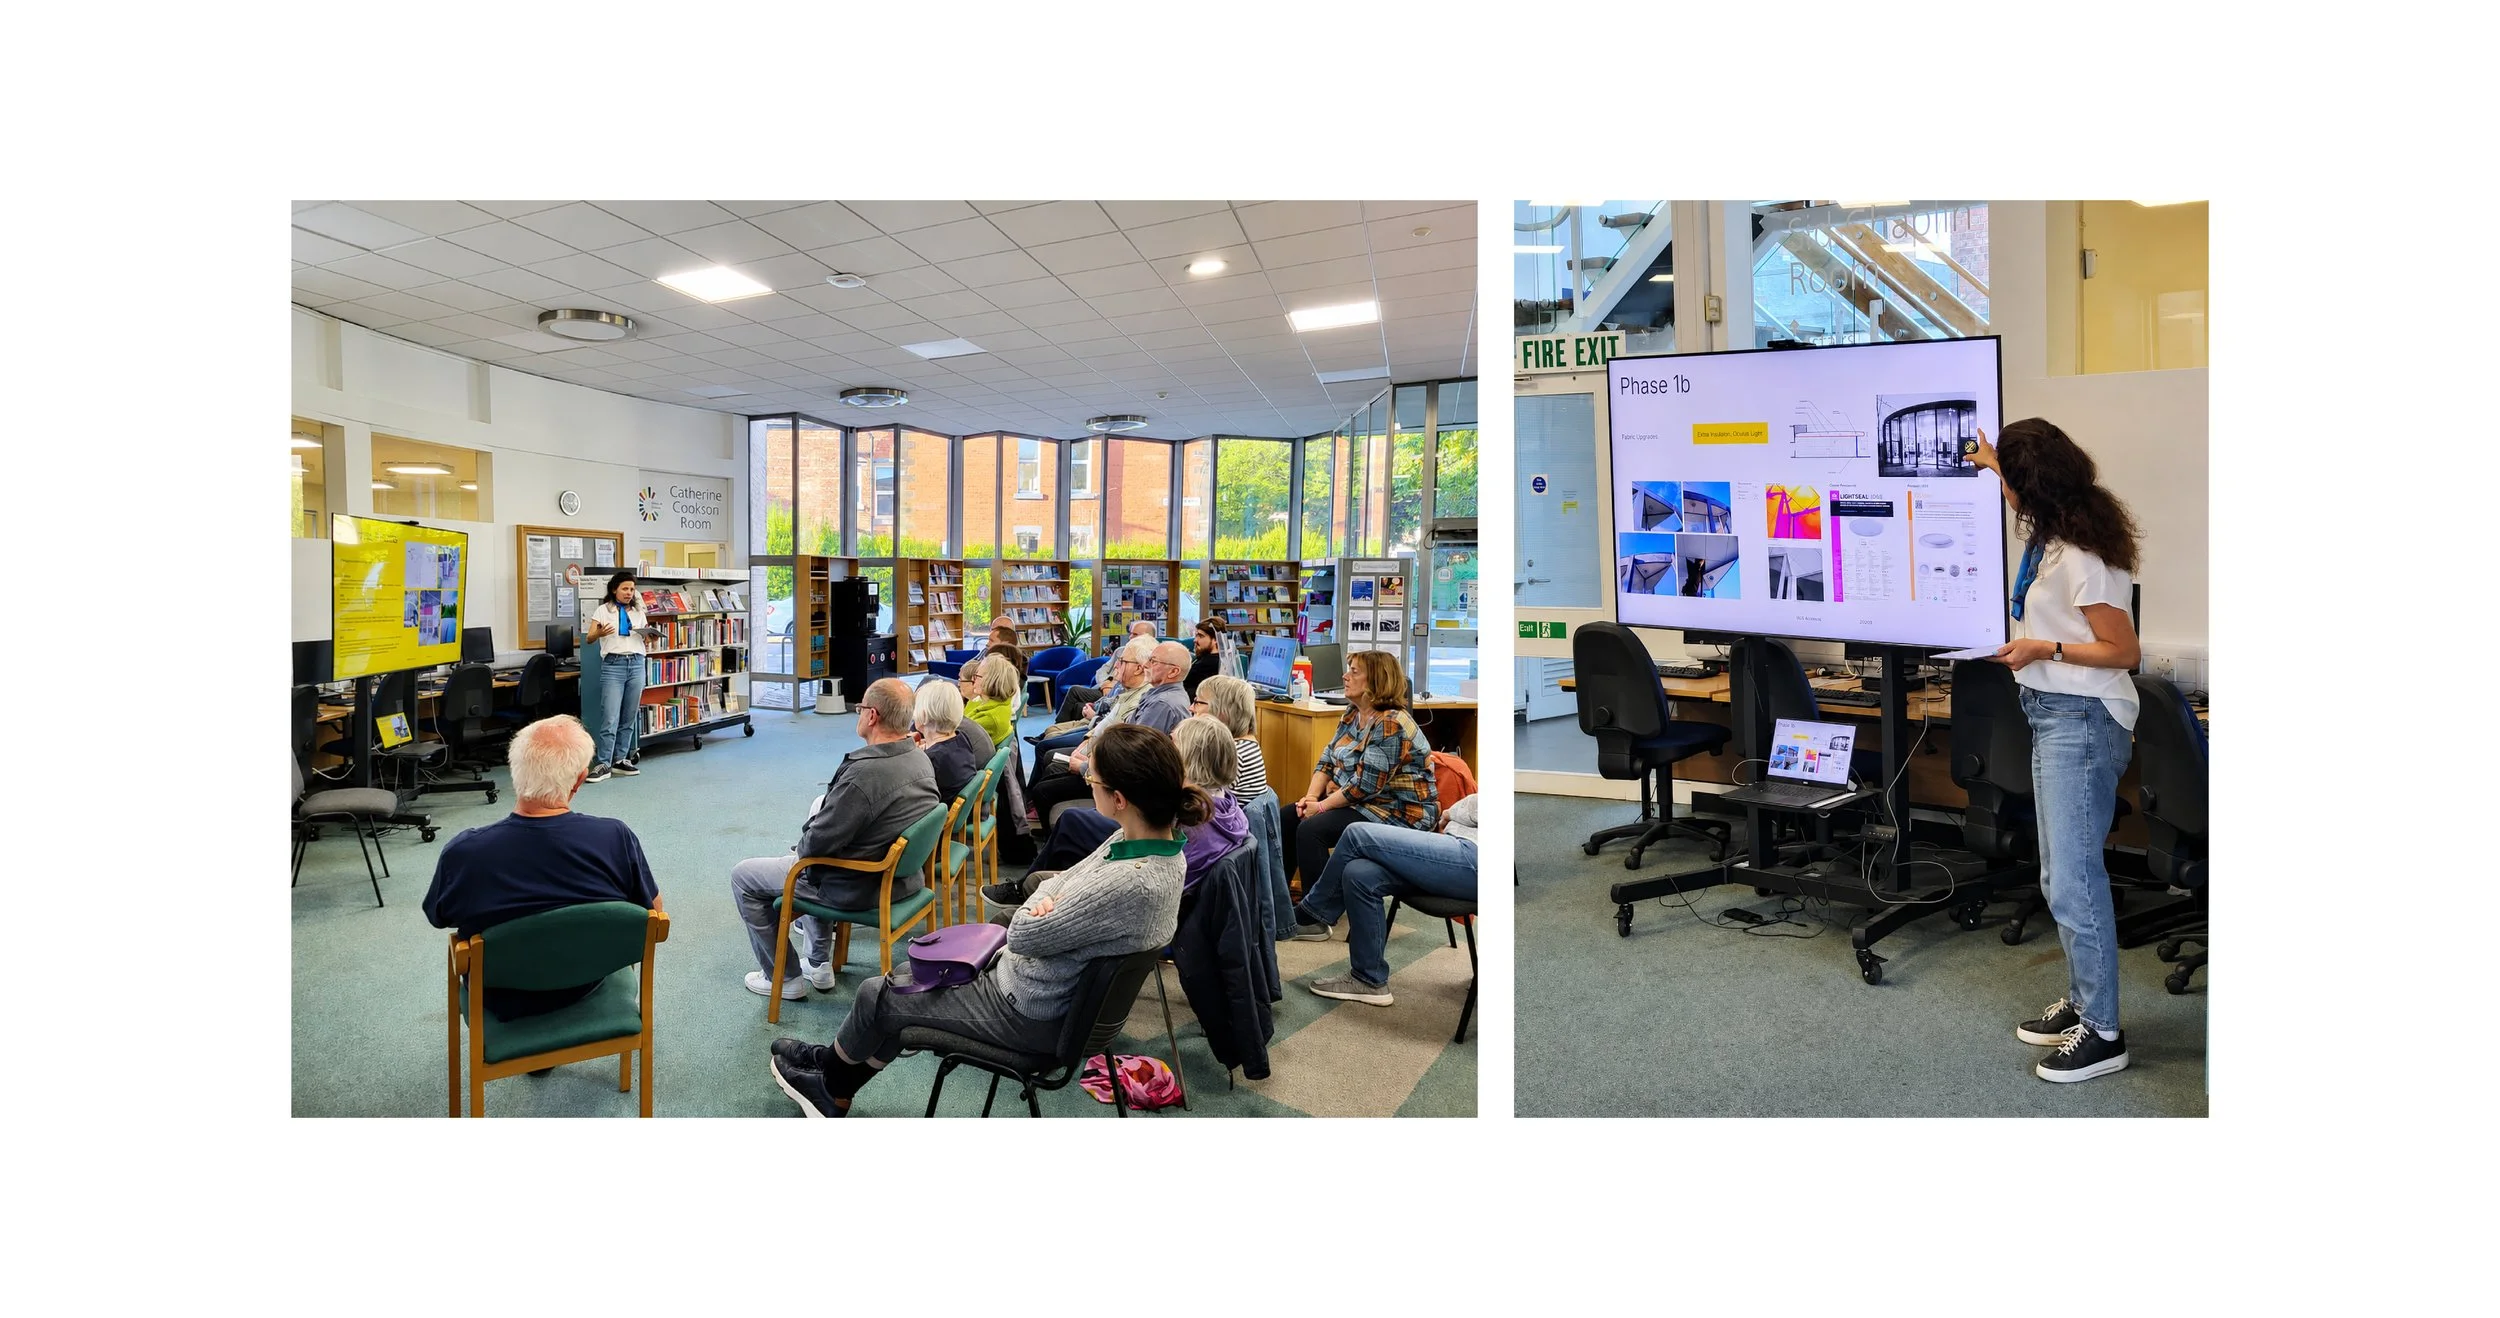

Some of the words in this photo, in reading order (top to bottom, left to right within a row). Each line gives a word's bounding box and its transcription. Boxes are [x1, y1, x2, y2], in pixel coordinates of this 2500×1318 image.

[1790, 261, 1880, 296] Room
[1522, 338, 1567, 369] FIRE
[1575, 335, 1620, 367] EXIT
[1620, 377, 1668, 396] Phase
[1673, 374, 1691, 393] 1b
[1621, 433, 1636, 441] Fabric
[1636, 433, 1659, 441] Upgrades
[1750, 430, 1763, 438] Light
[669, 485, 722, 502] Catherine
[672, 500, 720, 515] Cookson
[680, 516, 712, 530] Room
[1519, 623, 1534, 633] Exit
